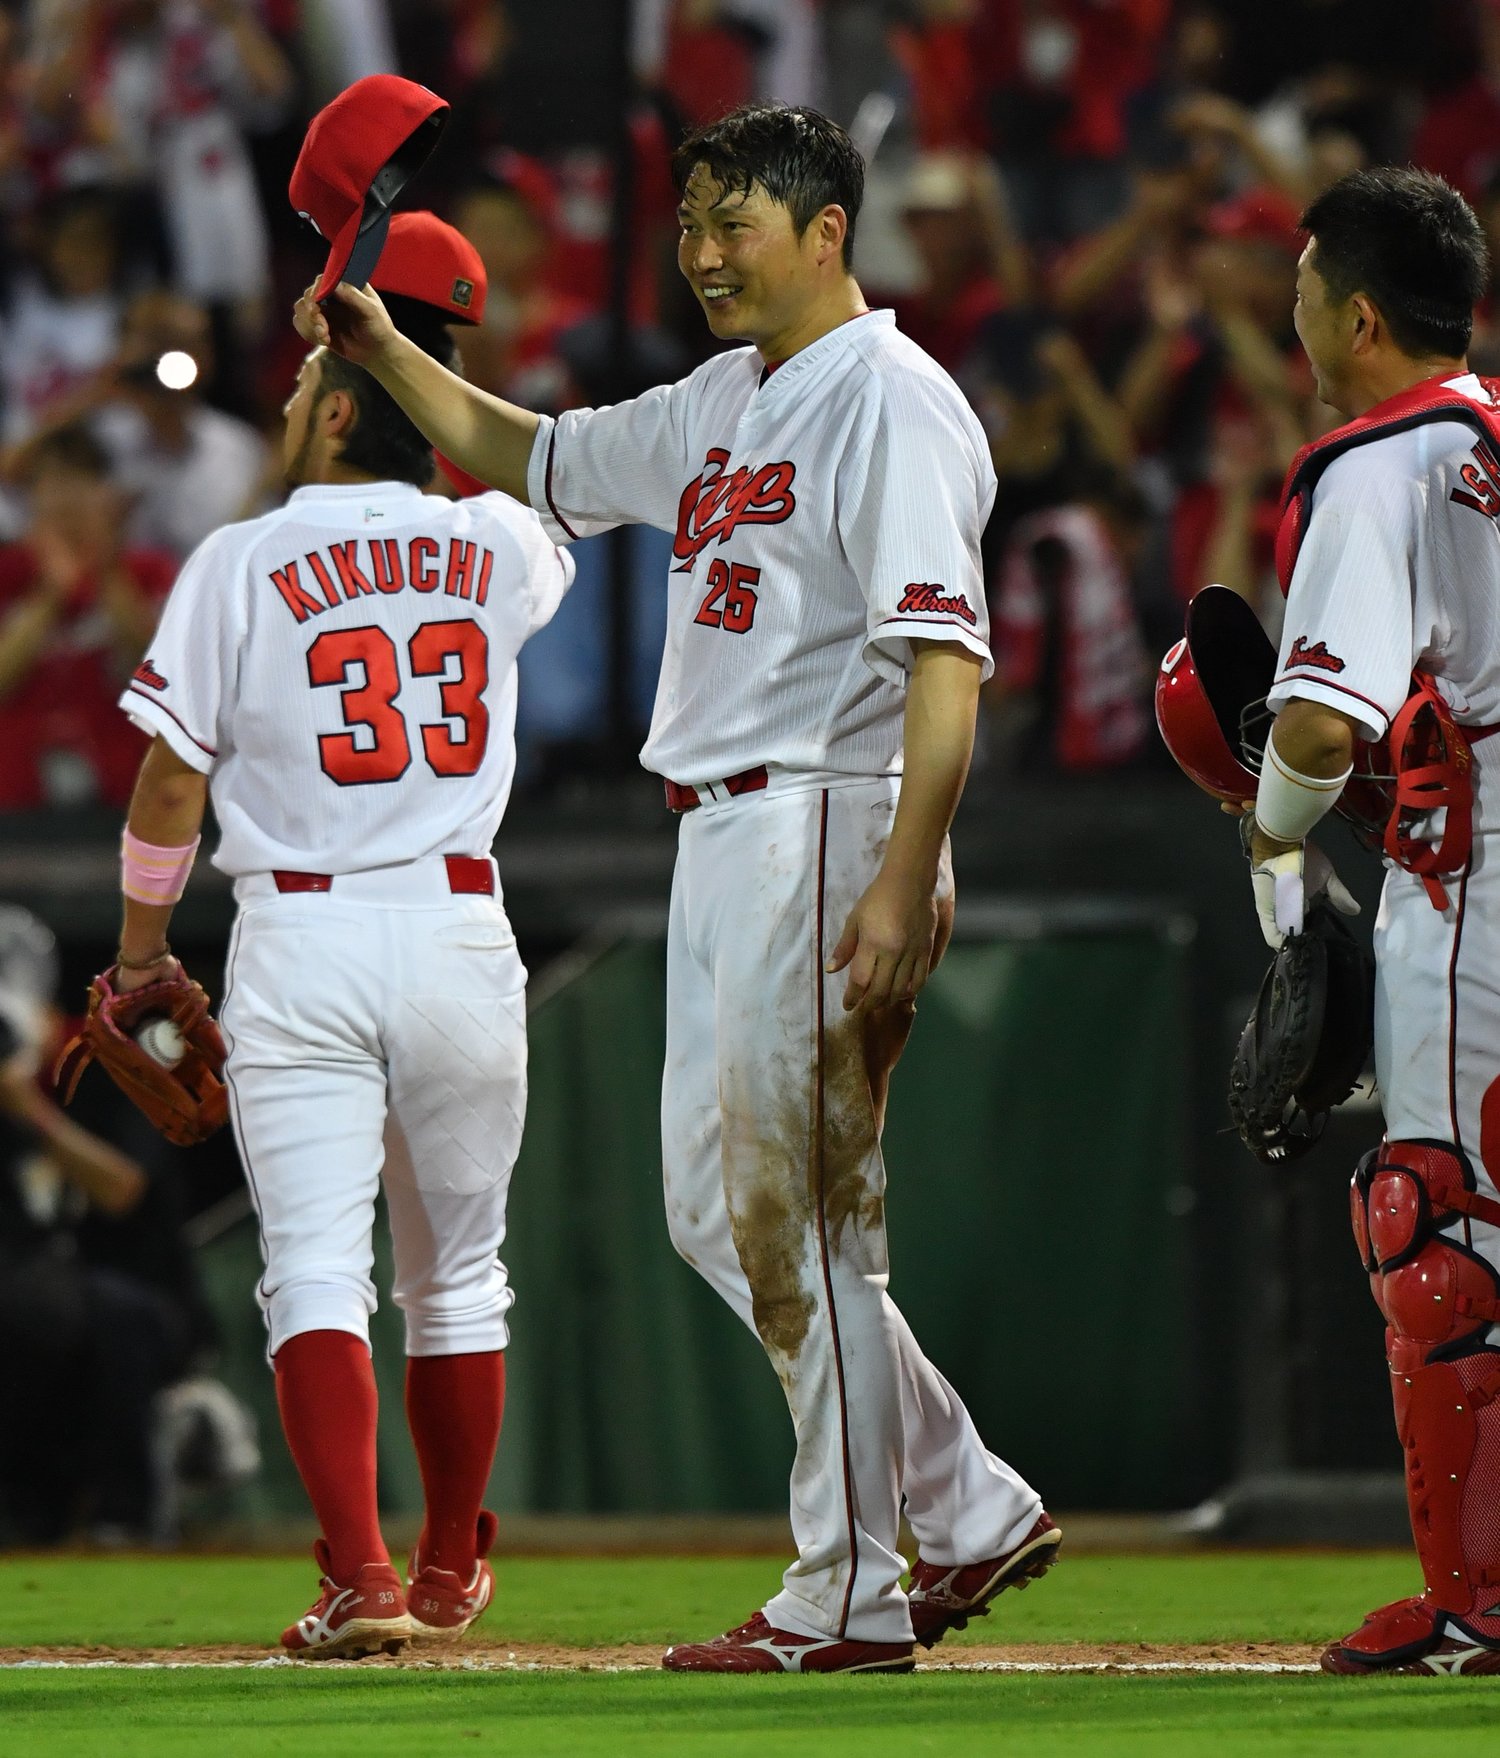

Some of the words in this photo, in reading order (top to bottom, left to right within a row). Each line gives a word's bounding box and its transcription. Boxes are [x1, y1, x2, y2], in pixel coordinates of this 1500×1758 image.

[671, 447, 797, 573] Carp
[268, 536, 494, 626] KIKUCHI
[693, 557, 762, 634] 25
[897, 582, 978, 627] Hiroshima
[305, 617, 490, 787] 33
[378, 1591, 395, 1605] 33
[422, 1599, 440, 1614] 33
